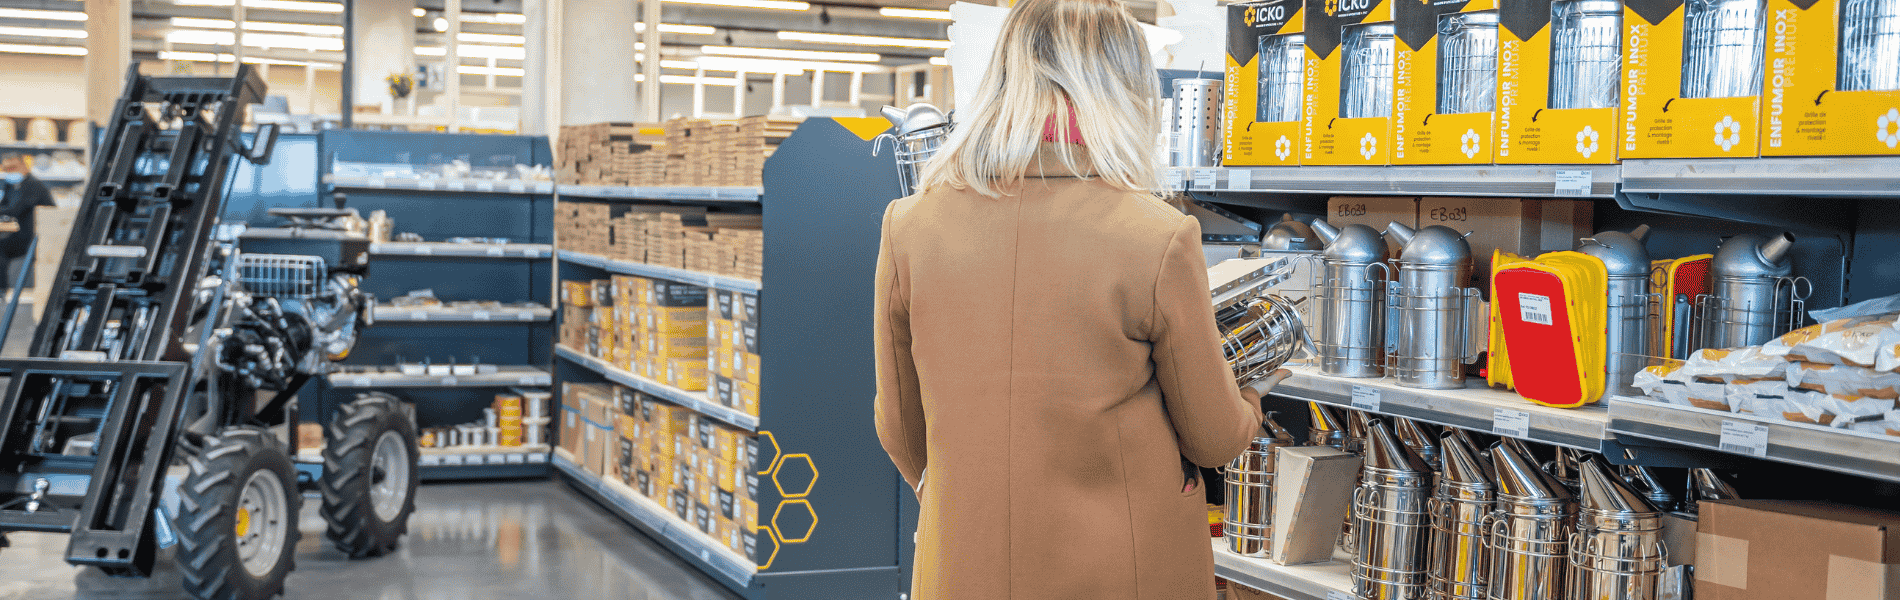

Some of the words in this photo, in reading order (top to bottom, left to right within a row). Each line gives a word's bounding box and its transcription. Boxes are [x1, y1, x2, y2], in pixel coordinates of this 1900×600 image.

[1256, 5, 1284, 22] ICKO
[1629, 24, 1640, 64] INOX
[1774, 9, 1787, 53] INOX
[1503, 40, 1512, 77] INOX
[1510, 40, 1519, 106] PREMIUM
[1637, 24, 1649, 95] PREMIUM
[1784, 8, 1797, 87] PREMIUM
[1404, 50, 1412, 111] PREMIUM
[1626, 69, 1638, 151] ENFUMOIR
[1770, 58, 1785, 147] ENFUMOIR
[1397, 88, 1405, 158] ENFUMOIR
[1500, 81, 1511, 156] ENFUMOIR
[1338, 204, 1366, 217] EB039
[1431, 206, 1466, 221] EB039
